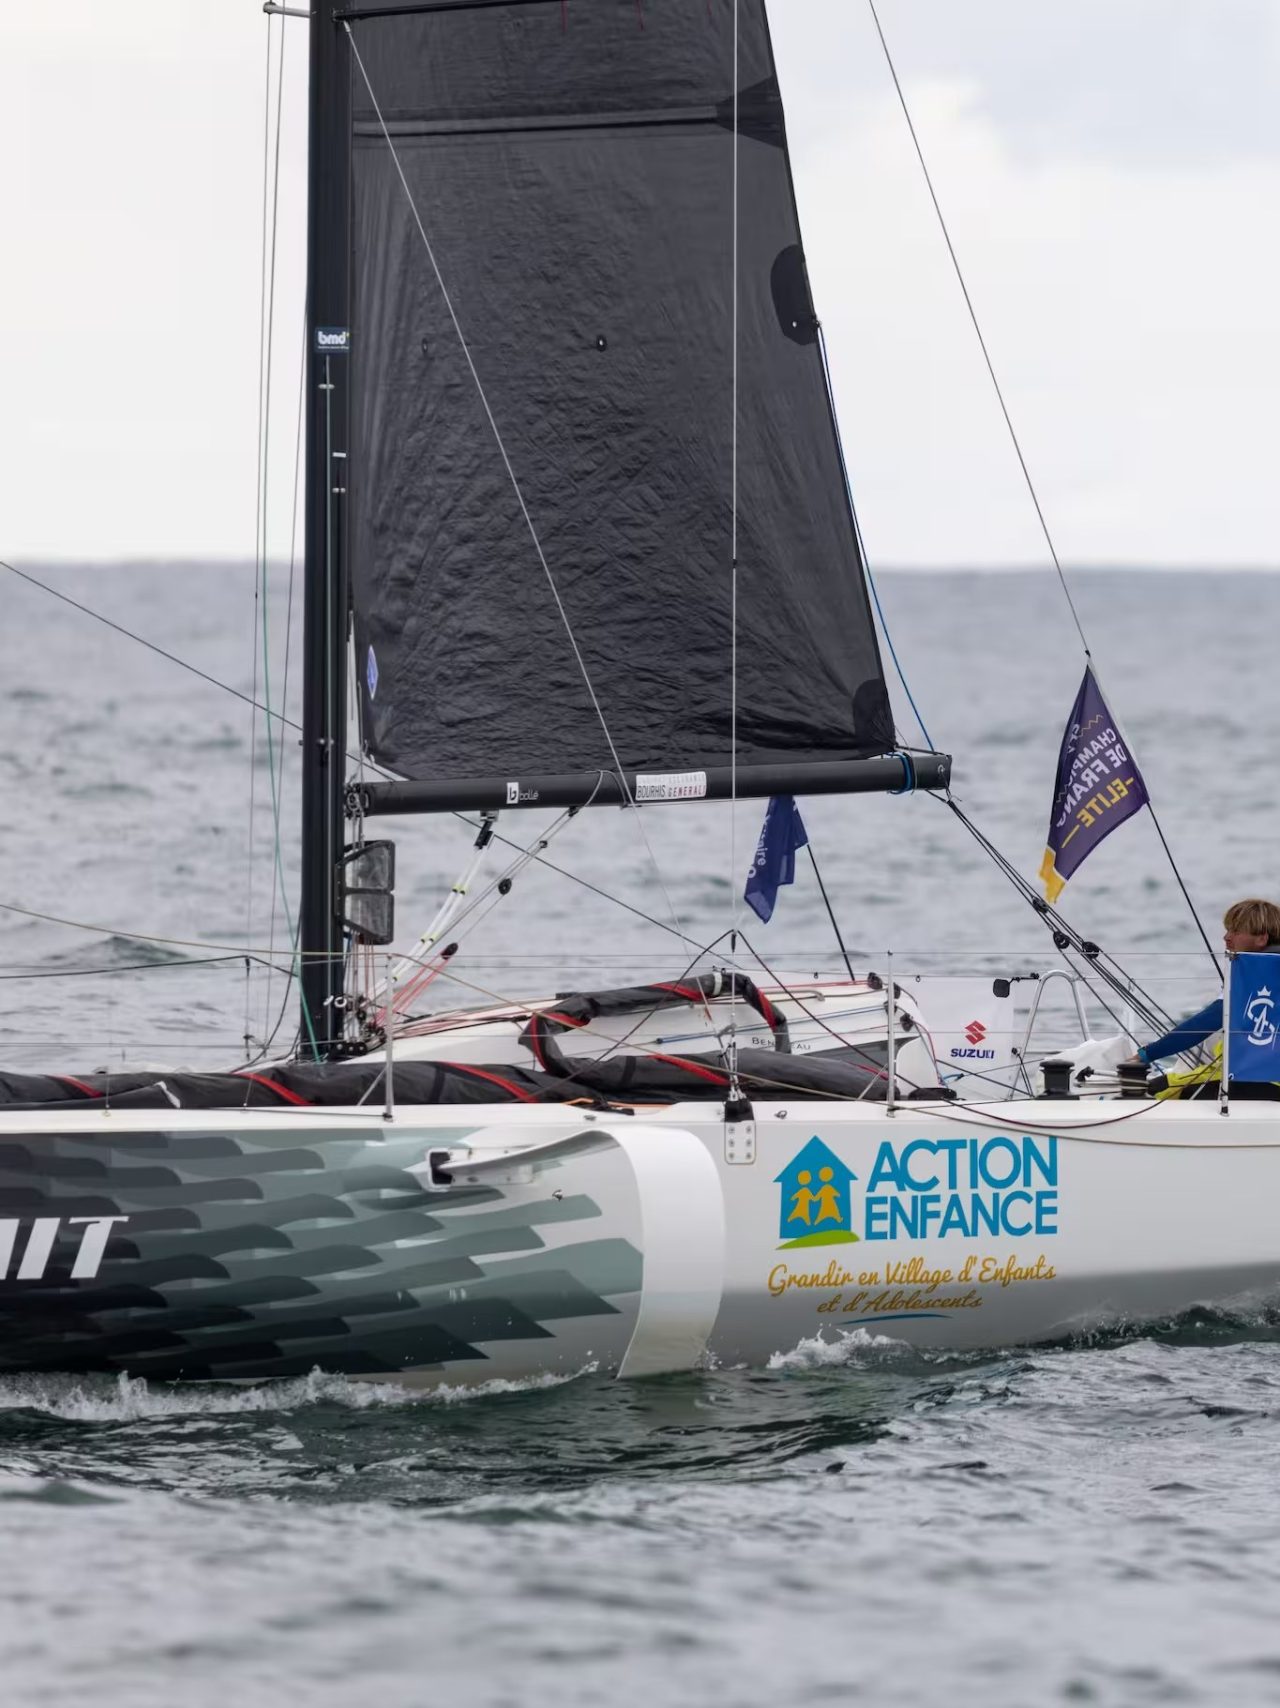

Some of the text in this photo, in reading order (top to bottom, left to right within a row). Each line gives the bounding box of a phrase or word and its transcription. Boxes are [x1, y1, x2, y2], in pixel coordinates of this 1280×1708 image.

[637, 785, 666, 798] BOURHIS
[866, 1136, 1058, 1193] ACTION
[865, 1190, 1058, 1240] ENFANCE
[768, 1259, 854, 1297] Grandir
[858, 1271, 881, 1286] en
[885, 1256, 953, 1294] Village
[817, 1293, 843, 1312] et
